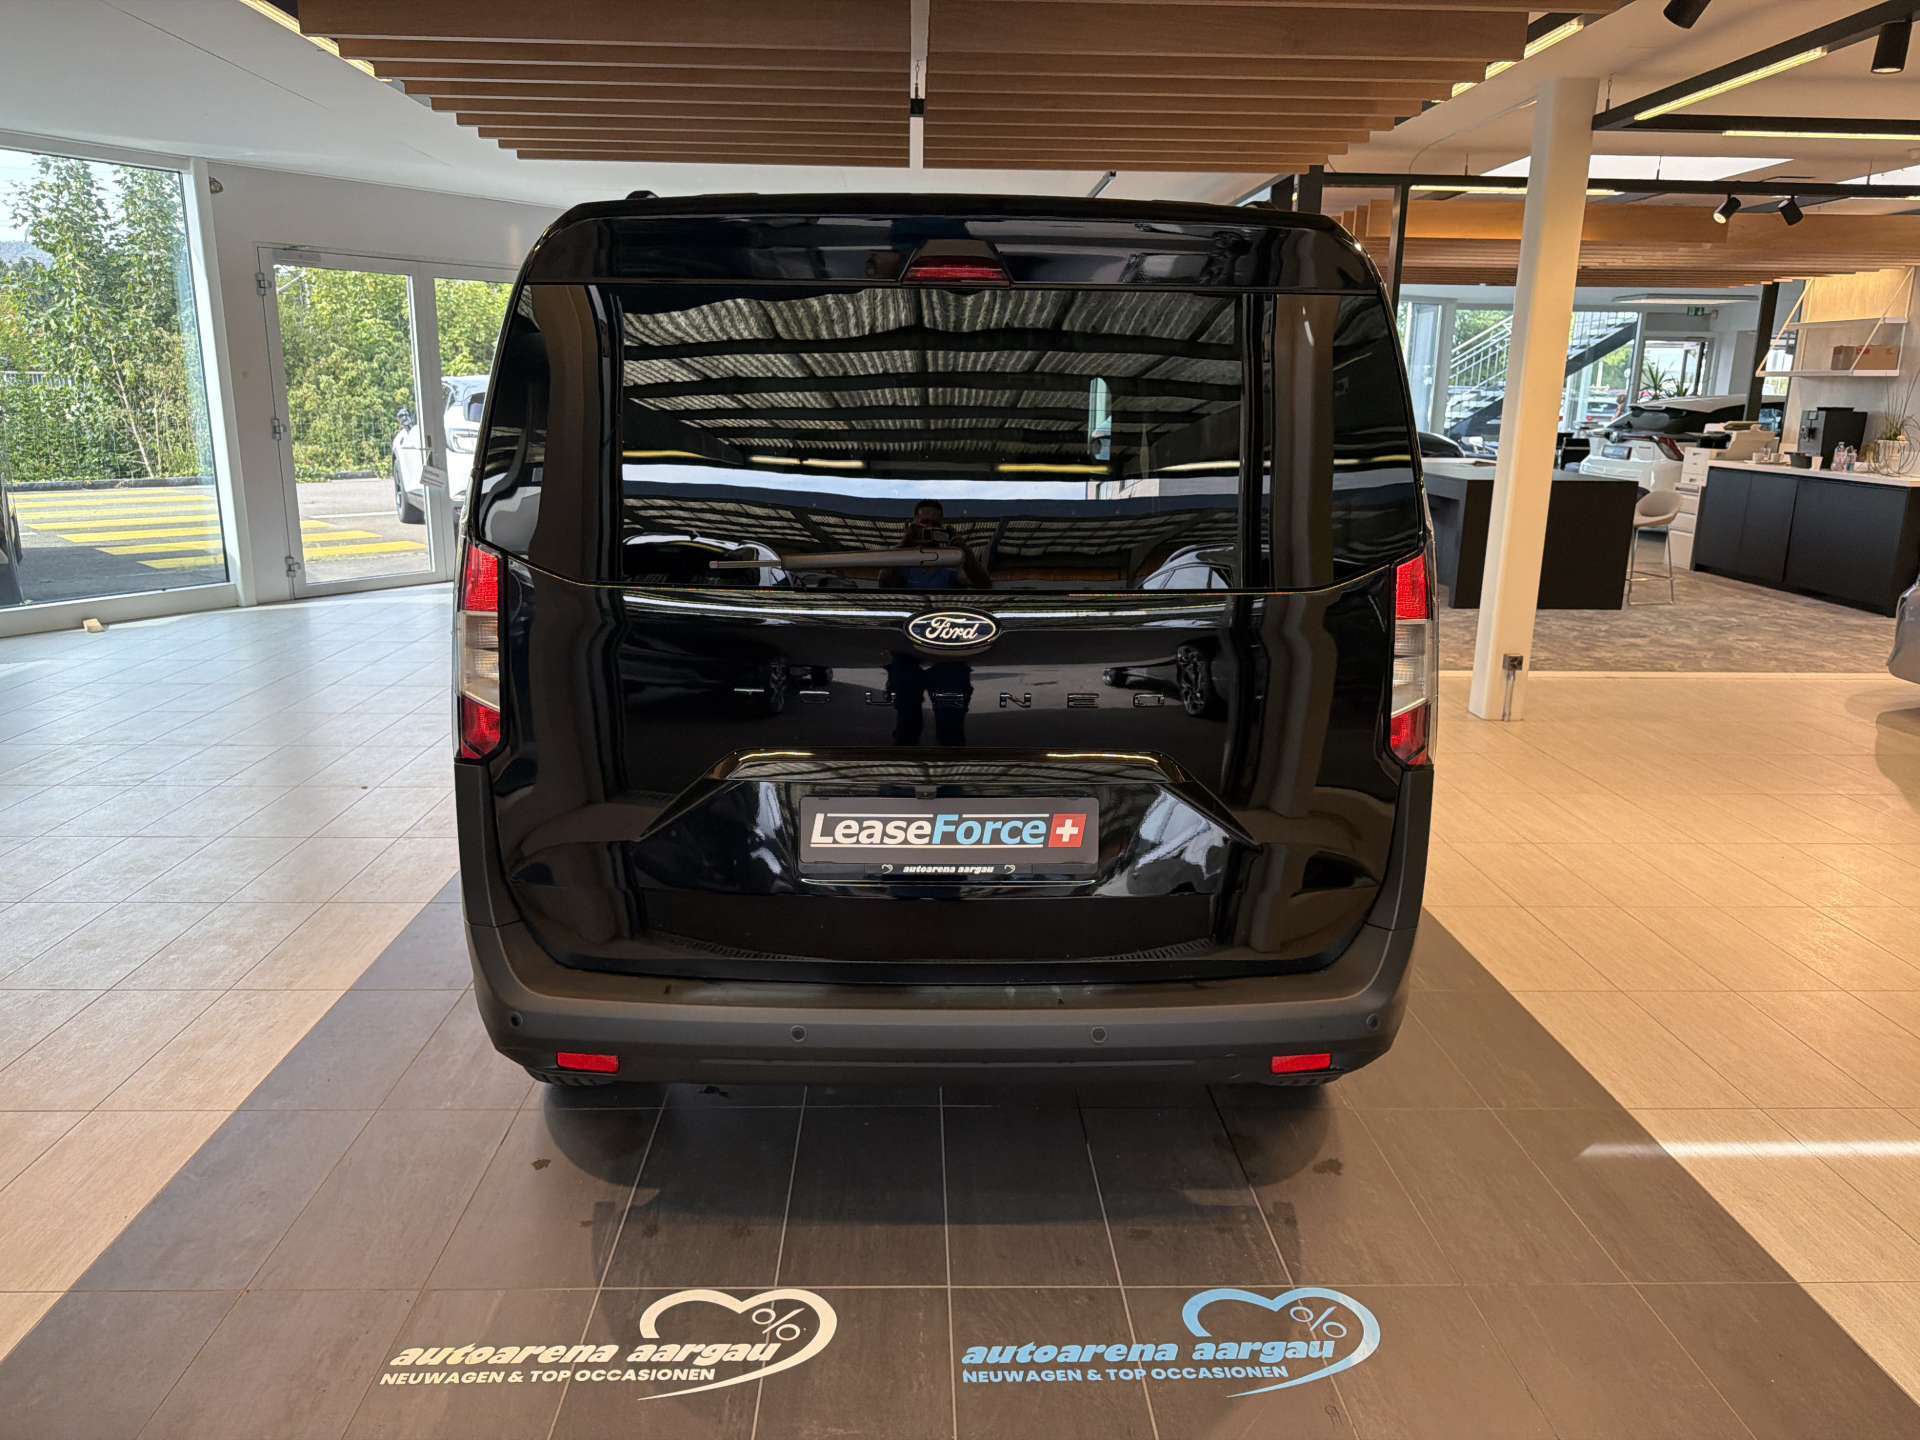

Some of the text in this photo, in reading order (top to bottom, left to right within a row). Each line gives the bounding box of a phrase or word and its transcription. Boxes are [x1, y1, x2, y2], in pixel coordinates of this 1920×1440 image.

[925, 616, 979, 639] Ford
[810, 813, 1047, 845] LeaseForce
[902, 865, 995, 875] autoarena aargau
[389, 1342, 782, 1367] autoarena aargau
[961, 1340, 1336, 1365] autoarena aargau
[379, 1368, 716, 1385] NEUWAGEN & TOP OCCASIONEN
[962, 1366, 1289, 1383] NEUWAGEN & TOP OCCASIONEN
